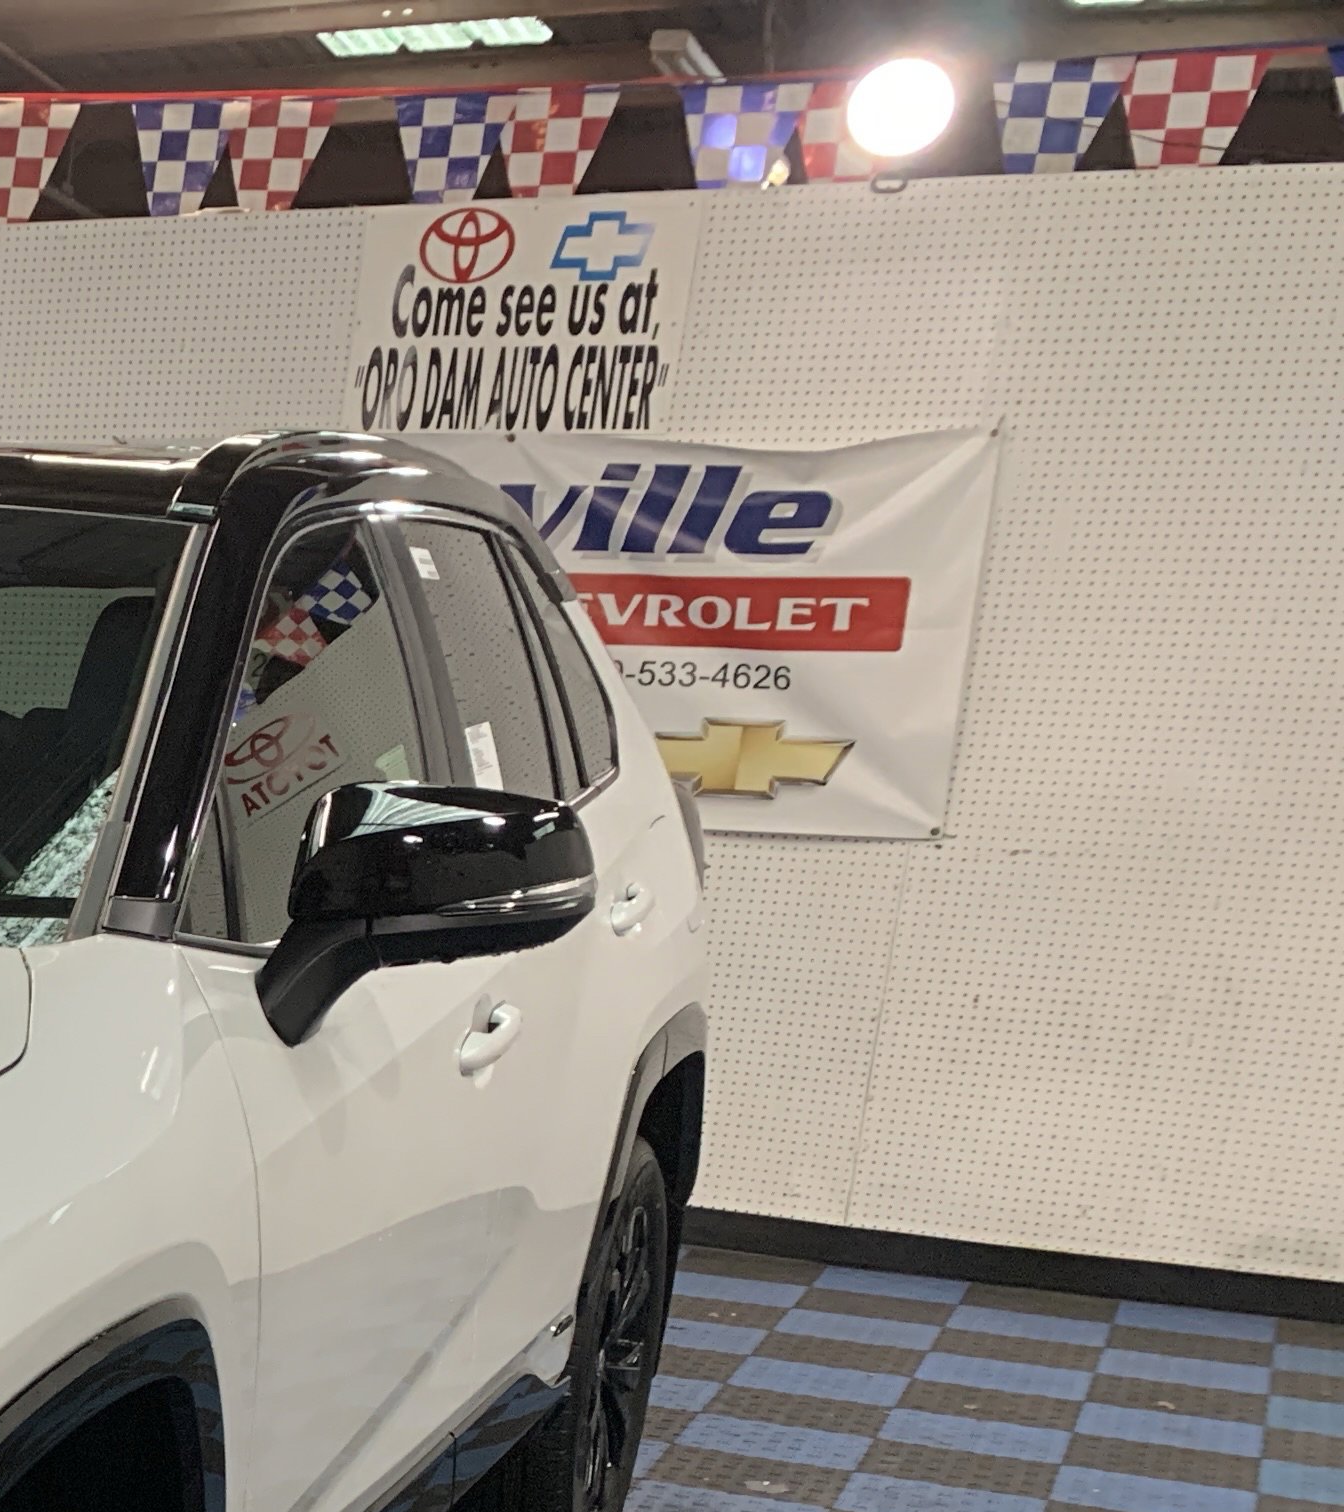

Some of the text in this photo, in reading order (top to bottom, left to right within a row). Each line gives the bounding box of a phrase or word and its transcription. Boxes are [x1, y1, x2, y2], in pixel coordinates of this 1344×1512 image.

[392, 264, 661, 340] Come see us at,
[354, 344, 669, 432] "ORO DAM AUTO CENTER"
